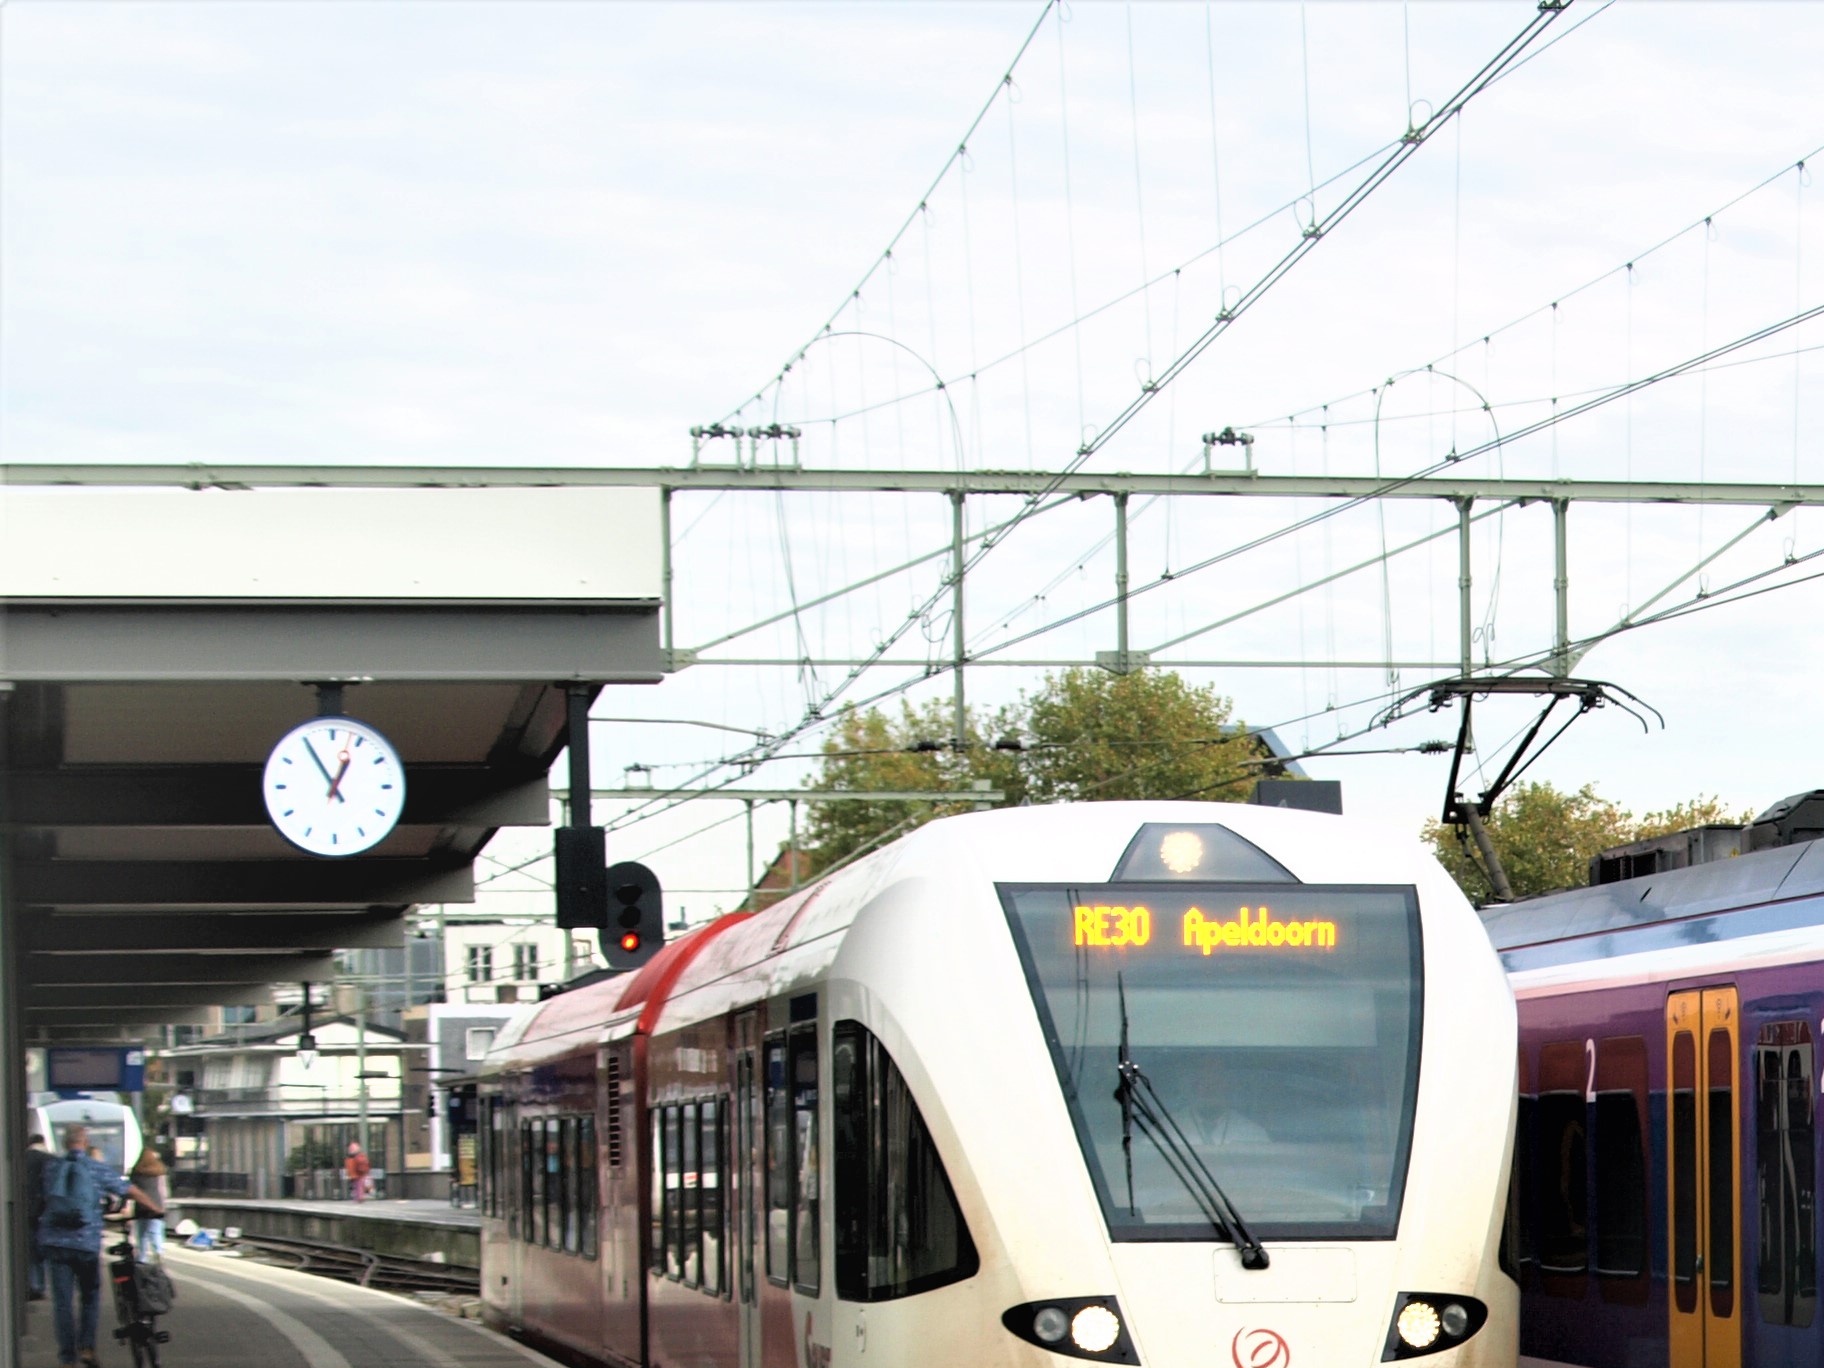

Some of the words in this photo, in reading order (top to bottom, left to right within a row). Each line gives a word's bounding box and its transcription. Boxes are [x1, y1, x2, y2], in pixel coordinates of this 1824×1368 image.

[1074, 906, 1150, 946] RE30
[1183, 906, 1336, 956] Apeldoorn
[1586, 1038, 1597, 1103] 2
